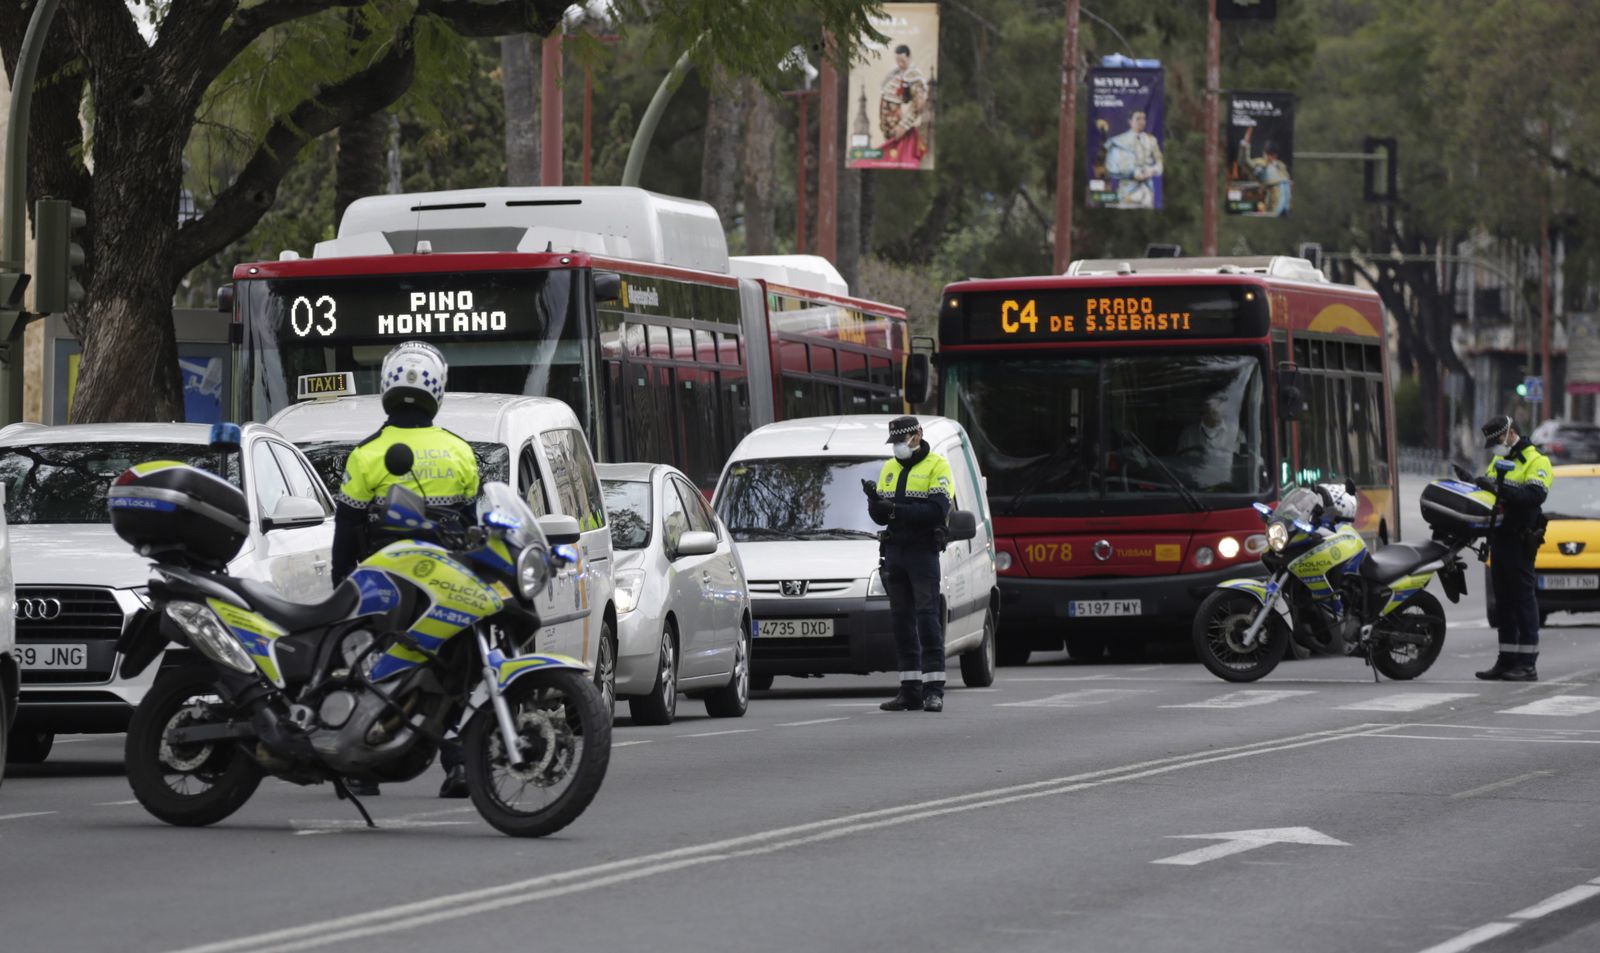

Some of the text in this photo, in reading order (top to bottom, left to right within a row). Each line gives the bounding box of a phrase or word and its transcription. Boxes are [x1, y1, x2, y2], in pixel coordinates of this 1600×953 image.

[410, 290, 474, 312] PINO
[1087, 297, 1153, 315] PRADO
[291, 295, 337, 337] 03
[378, 311, 507, 335] MONTANO
[1001, 299, 1038, 333] C4
[1050, 312, 1191, 332] DE S.SEBASTI
[308, 375, 337, 393] TAXI
[415, 449, 452, 460] LICIA
[1025, 543, 1072, 562] 1078
[1116, 549, 1152, 557] TUSSAM
[448, 593, 485, 611] LOCAL
[1077, 601, 1140, 615] 5197 FMY
[762, 621, 827, 636] 4735 DXD
[44, 647, 82, 666] JNG
